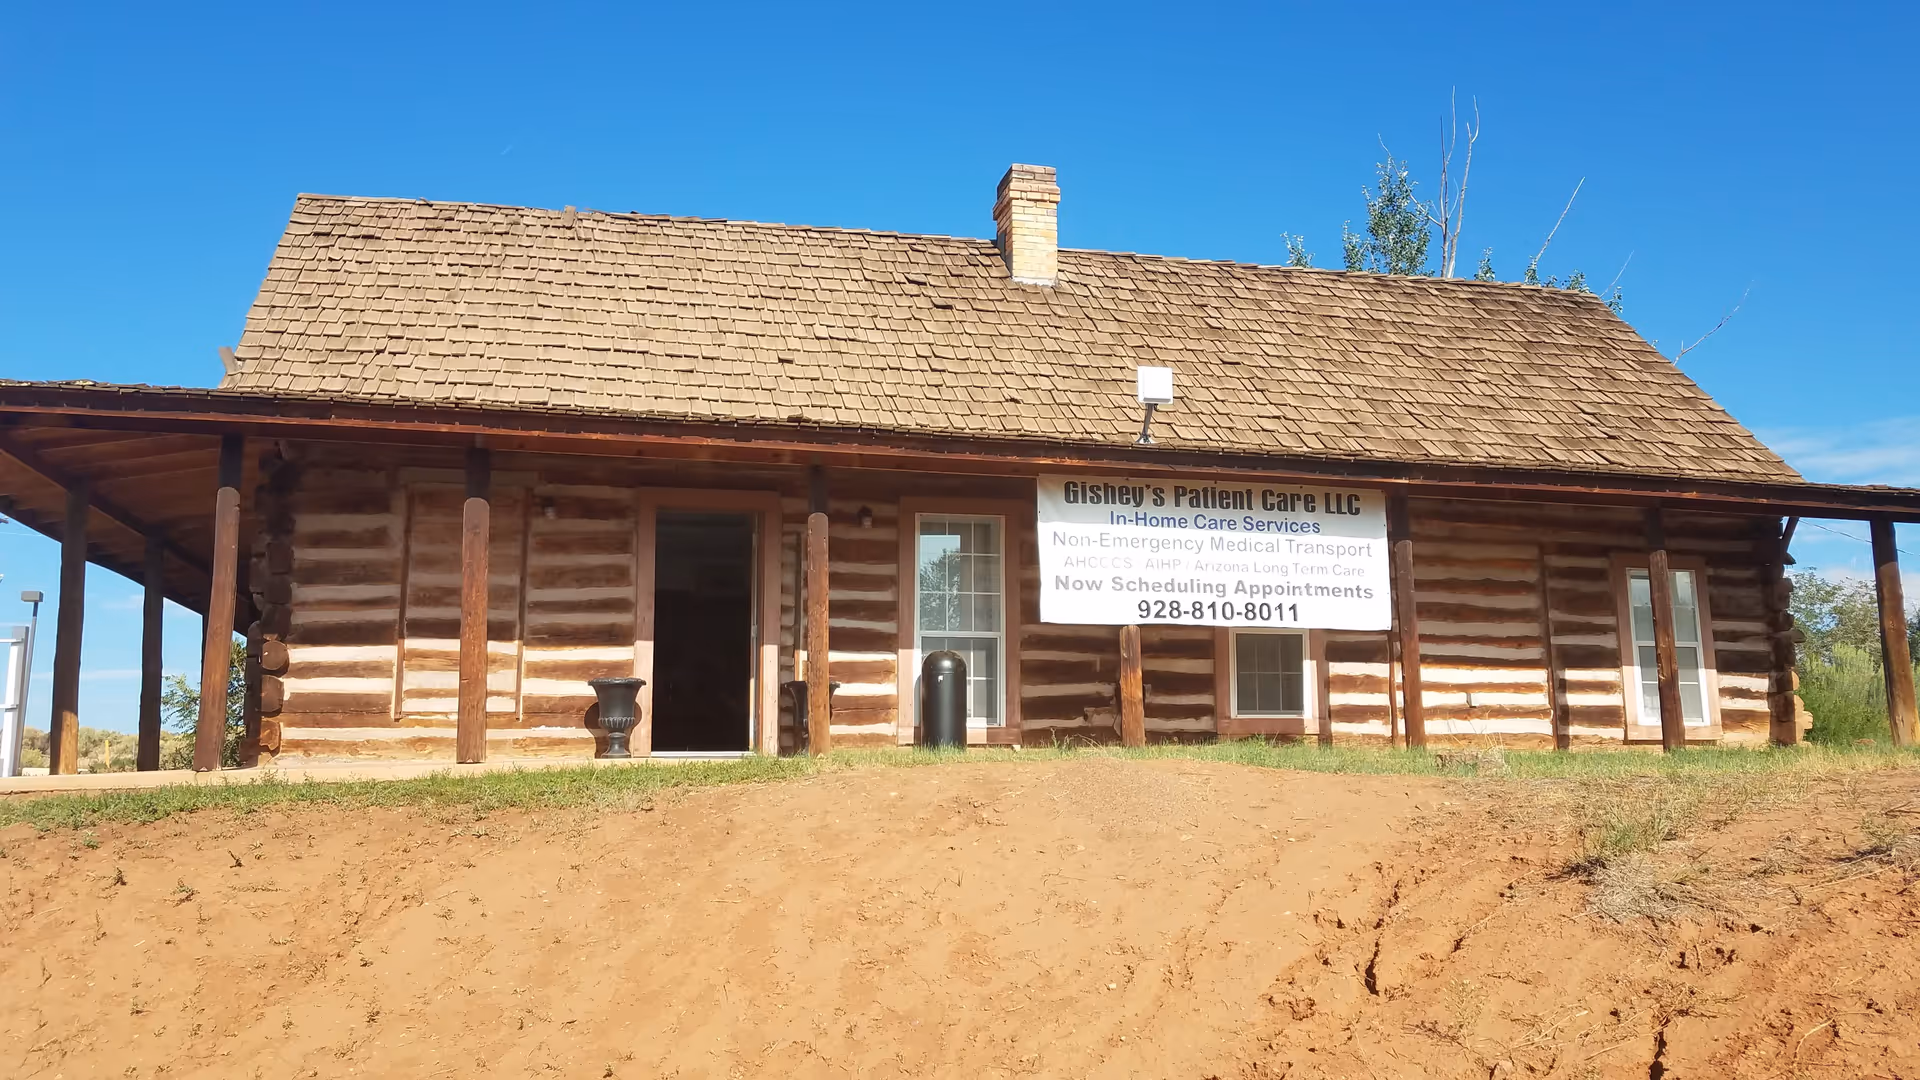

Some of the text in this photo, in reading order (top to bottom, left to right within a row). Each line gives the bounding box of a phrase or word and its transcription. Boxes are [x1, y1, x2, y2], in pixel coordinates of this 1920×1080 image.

[1064, 480, 1361, 515] Gishey's Patient Care LLC
[1110, 511, 1321, 534] In-Home Care Services
[1053, 531, 1373, 560] Non-Emergency Medical Transport
[1064, 556, 1133, 569] AHCCCS
[1146, 558, 1181, 570] AIHP
[1194, 560, 1249, 573] Arizona
[1253, 562, 1289, 577] Long
[1292, 564, 1328, 575] Term
[1333, 565, 1365, 577] Care
[1054, 575, 1374, 599] Now Scheduling Appointments
[1138, 600, 1298, 621] 928-810-8011
